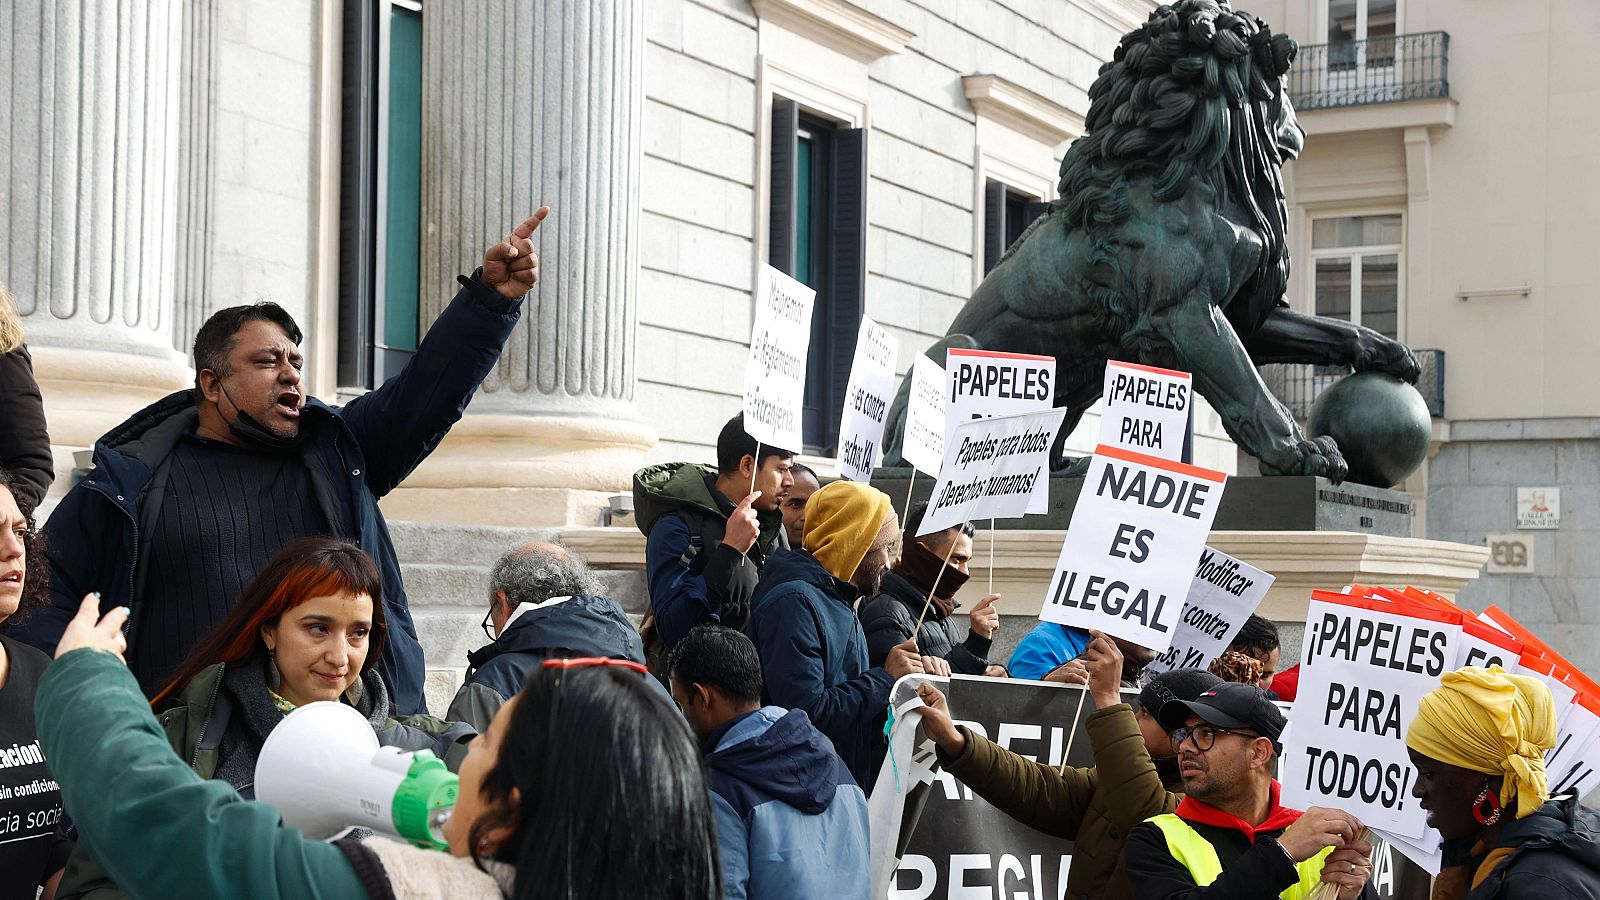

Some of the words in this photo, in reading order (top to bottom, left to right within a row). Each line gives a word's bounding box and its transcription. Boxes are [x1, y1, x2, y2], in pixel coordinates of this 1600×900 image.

[760, 330, 800, 380] Reglamento
[952, 364, 1049, 403] ¡PAPELES
[1108, 374, 1187, 411] ¡PAPELES
[955, 433, 998, 470] Papeles
[992, 435, 1020, 465] para
[1120, 417, 1162, 449] PARA
[1096, 463, 1210, 519] NADIE
[1108, 523, 1154, 564] ES
[1195, 549, 1253, 597] Modificar
[1052, 570, 1168, 633] ILEGAL
[1184, 606, 1230, 640] contra
[1307, 612, 1447, 677] ¡PAPELES
[1324, 682, 1401, 739] PARA
[1305, 746, 1410, 811] TODOS!
